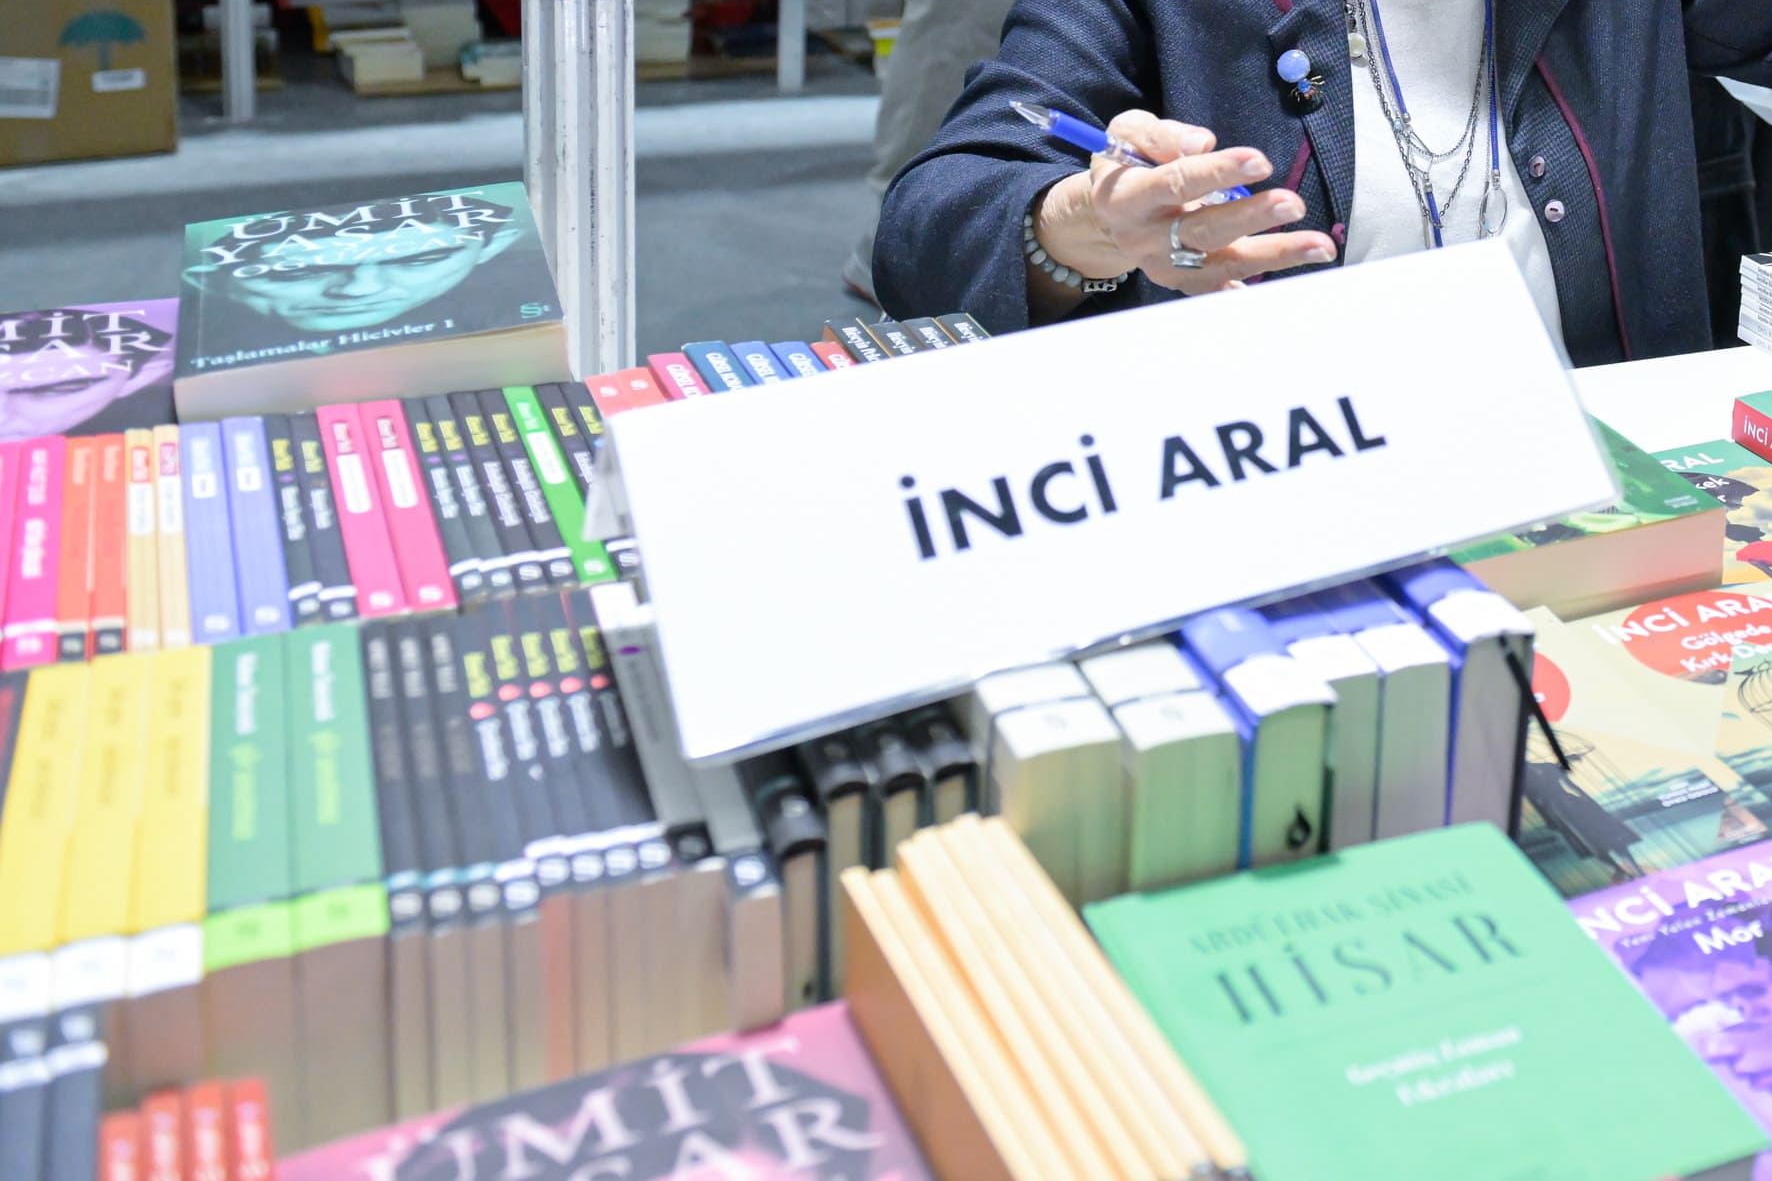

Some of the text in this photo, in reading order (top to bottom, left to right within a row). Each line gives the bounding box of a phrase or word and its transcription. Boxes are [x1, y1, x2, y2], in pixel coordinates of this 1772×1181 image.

[225, 191, 484, 240] ÜMİT
[1743, 414, 1769, 446] İNCİ
[900, 396, 1387, 560] İNCİ ARAL
[1592, 607, 1690, 645] İNCİ
[1681, 623, 1772, 651] Gölgede
[1681, 651, 1733, 673] Kırk
[1577, 885, 1674, 940] NCİ
[1693, 920, 1764, 955] Mor
[1216, 914, 1522, 1024] HİSAR
